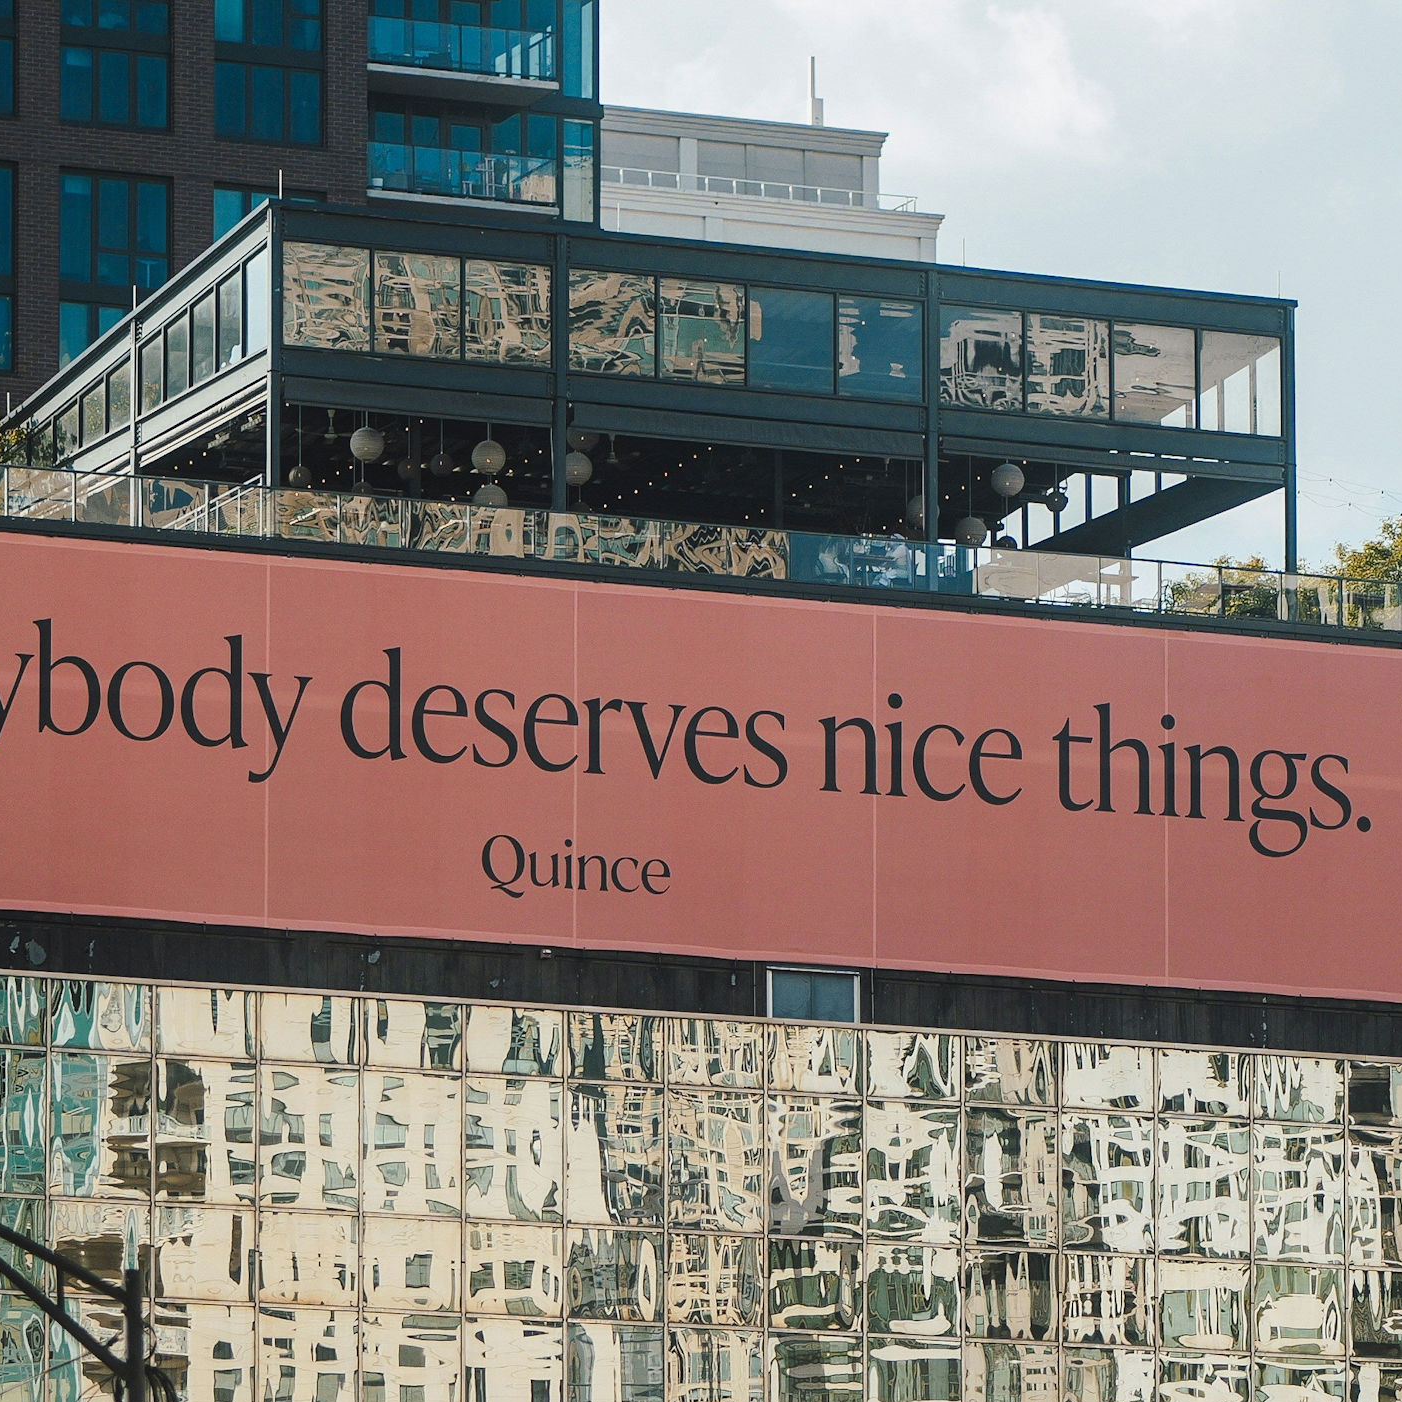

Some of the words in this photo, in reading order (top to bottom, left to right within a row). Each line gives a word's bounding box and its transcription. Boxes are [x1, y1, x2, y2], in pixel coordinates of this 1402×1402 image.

[340, 647, 788, 788] deserves
[818, 693, 1023, 805] nice
[1052, 702, 1372, 857] things.
[482, 835, 671, 898] Quince
